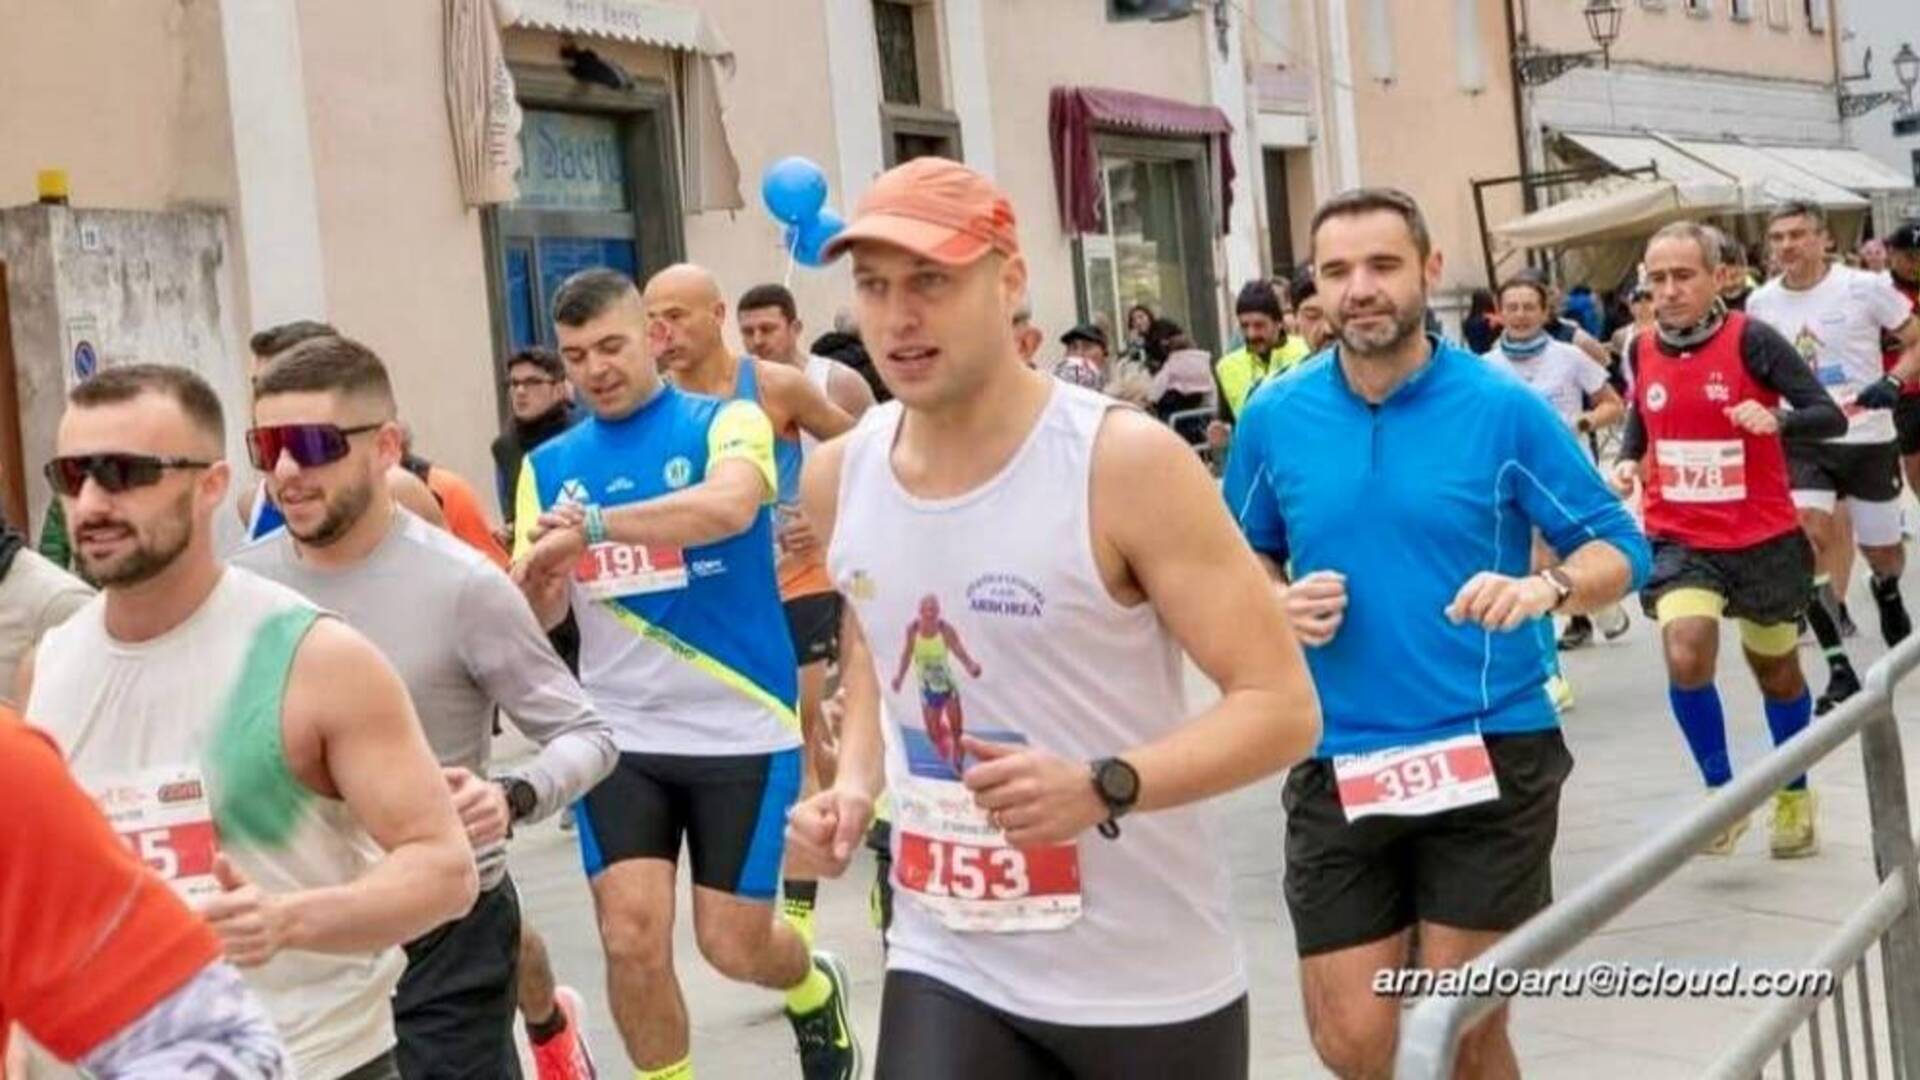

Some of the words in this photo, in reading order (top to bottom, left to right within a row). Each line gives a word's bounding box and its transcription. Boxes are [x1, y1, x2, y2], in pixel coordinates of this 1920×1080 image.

[1676, 465, 1723, 491] 178
[595, 545, 655, 578] 191
[971, 599, 1043, 617] ARBOREA
[1373, 754, 1460, 800] 391
[924, 842, 1030, 899] 153
